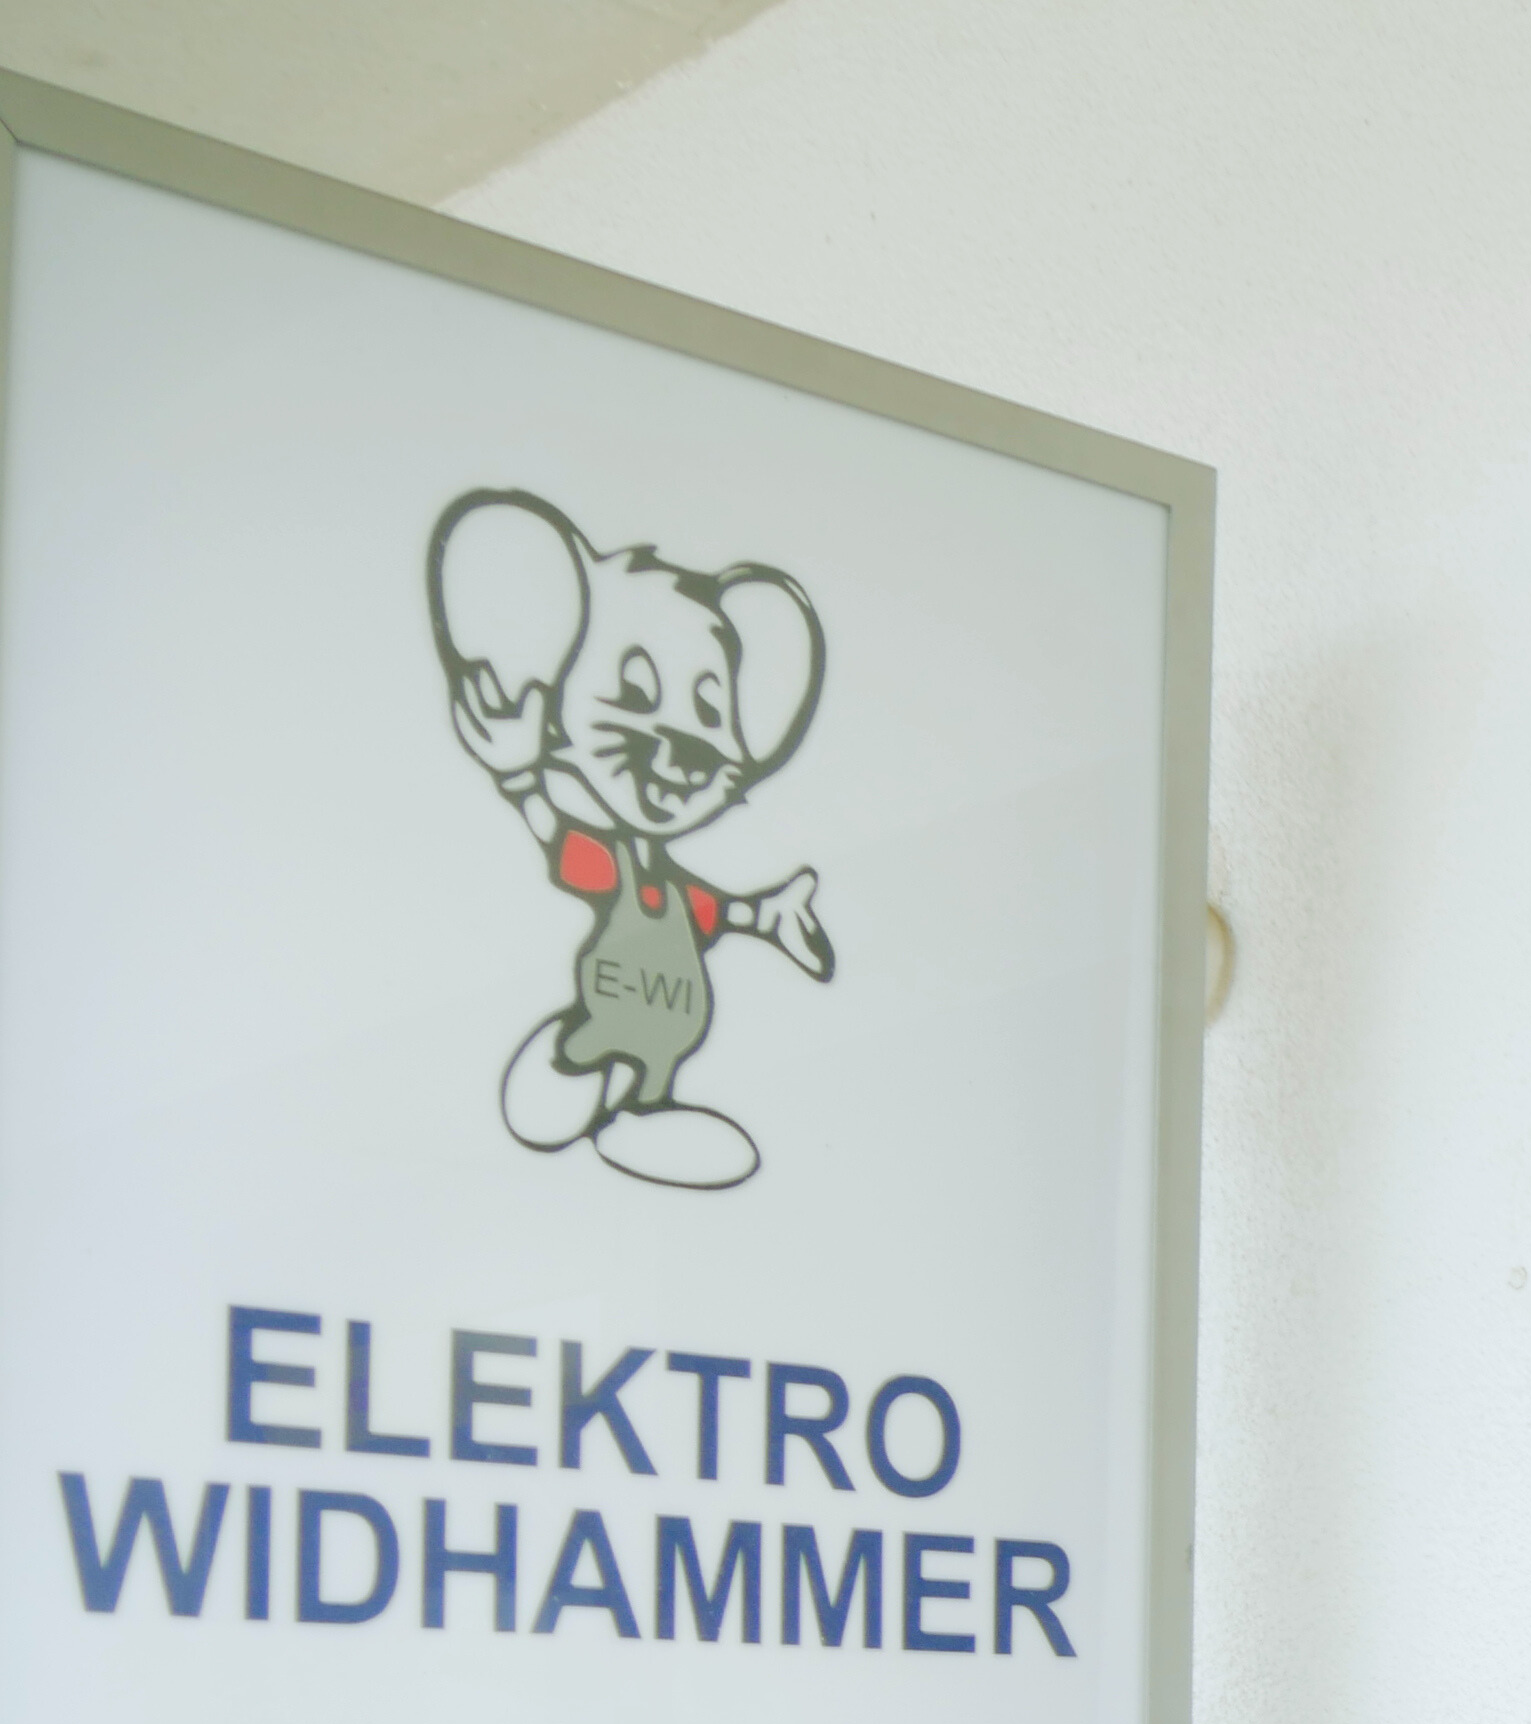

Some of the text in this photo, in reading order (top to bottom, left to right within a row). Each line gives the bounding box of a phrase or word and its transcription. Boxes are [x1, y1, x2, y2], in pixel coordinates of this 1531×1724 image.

[594, 958, 693, 1015] E-WI
[226, 1305, 962, 1498] ELEKTRO
[57, 1471, 1078, 1658] WIDHAMMER
